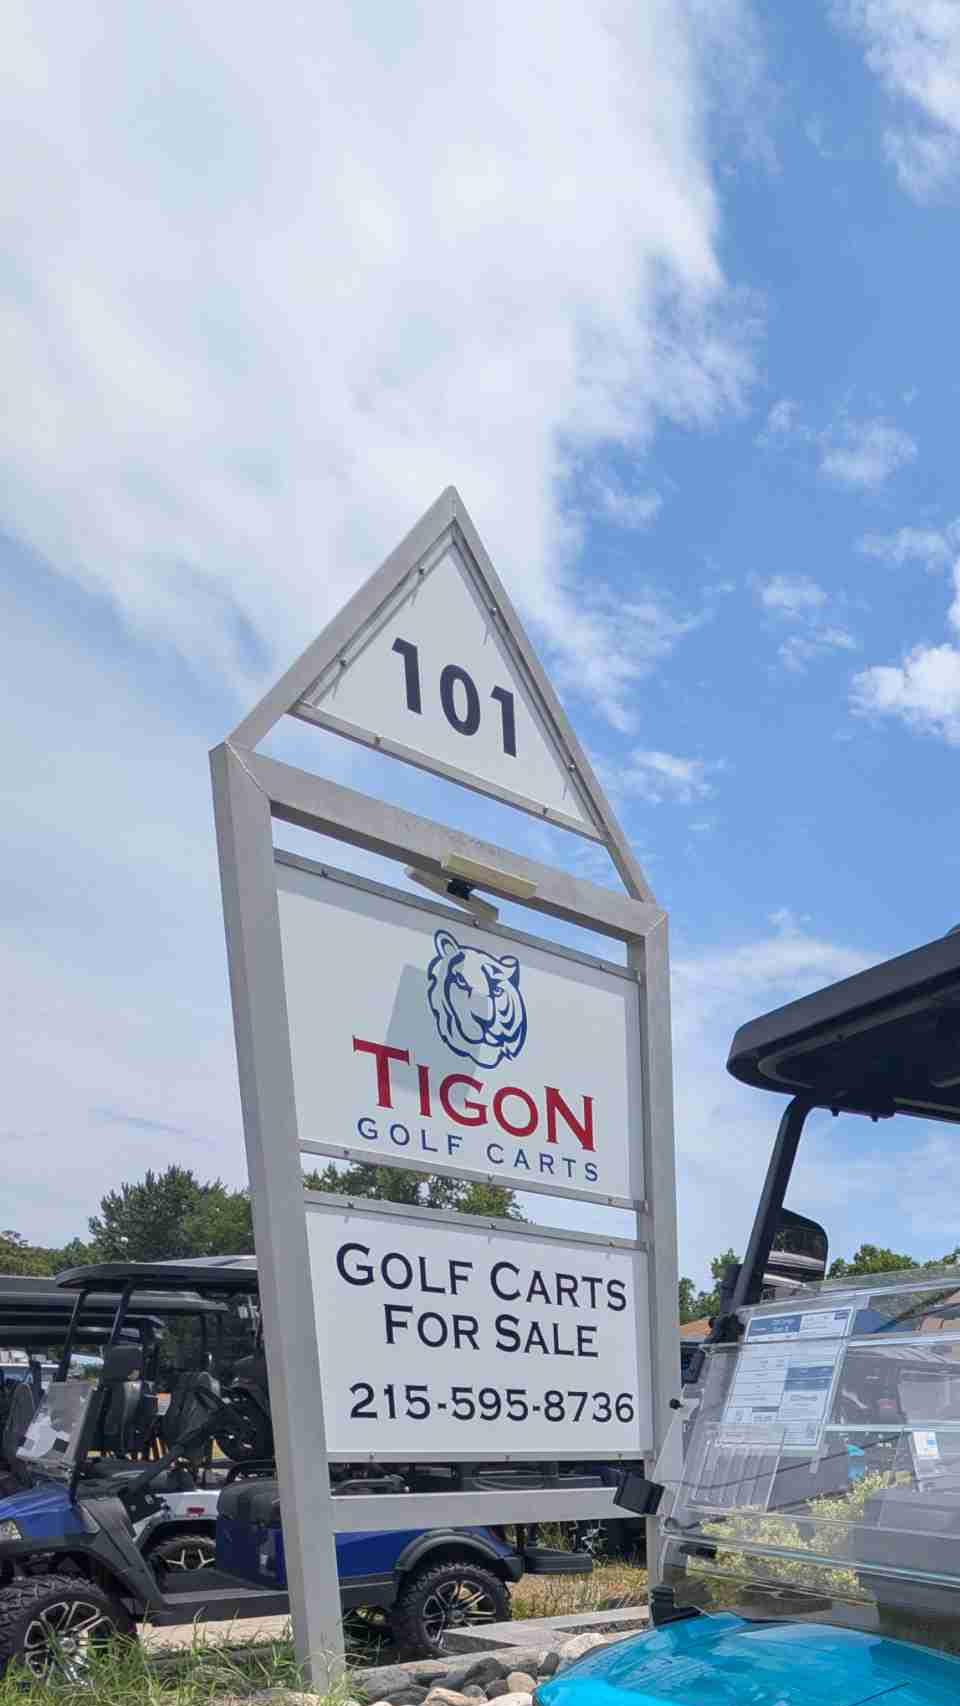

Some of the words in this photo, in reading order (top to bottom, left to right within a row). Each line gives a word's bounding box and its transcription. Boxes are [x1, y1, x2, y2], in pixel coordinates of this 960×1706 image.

[391, 637, 517, 758] 101
[352, 1034, 597, 1152] TIGON
[357, 1117, 463, 1155] GOLF
[486, 1143, 599, 1183] CARTS
[336, 1242, 474, 1296] GOLF
[489, 1261, 627, 1312] CARTS
[383, 1303, 480, 1351] FOR
[494, 1313, 599, 1358] SALE
[349, 1382, 634, 1424] 215-595-8736
